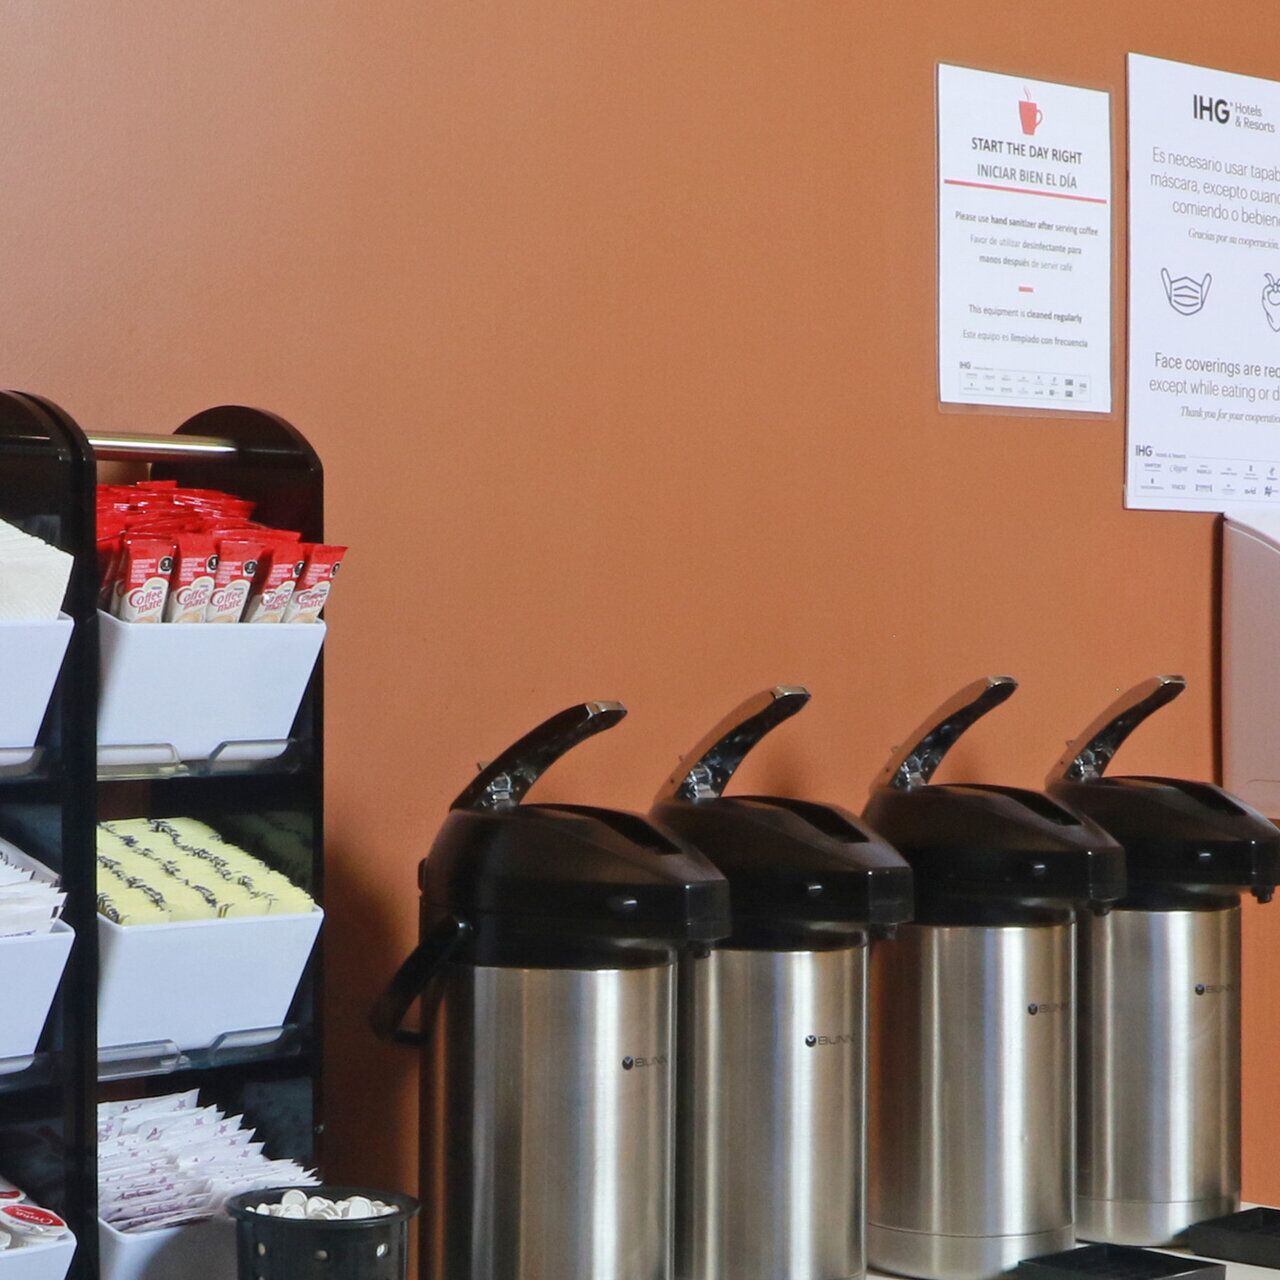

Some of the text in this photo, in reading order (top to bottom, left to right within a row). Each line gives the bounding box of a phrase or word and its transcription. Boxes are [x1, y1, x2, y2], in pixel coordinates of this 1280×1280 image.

[1192, 93, 1231, 125] IHG
[1234, 101, 1263, 118] Hotels
[1234, 117, 1276, 134] & Resorts
[971, 137, 1082, 164] START THE DAY RIGHT
[1152, 146, 1166, 164] Es
[1168, 151, 1223, 173] necesario
[1224, 160, 1248, 177] usar
[977, 163, 1077, 189] INICIAR BIEN EL DÍA
[1150, 172, 1201, 195] máscara,
[1203, 181, 1248, 200] excepto
[1172, 200, 1230, 221] comiendo
[1231, 209, 1240, 222] o
[955, 210, 1099, 237] Please use hand sanitizer after serving coffee
[1188, 227, 1216, 241] Gracias
[1215, 232, 1228, 244] por
[979, 255, 1001, 265] manos
[969, 304, 982, 315] This
[983, 306, 1019, 318] equipment
[1026, 309, 1053, 321] cleaned
[1053, 312, 1083, 325] regularly
[977, 332, 1000, 342] equipo
[1054, 335, 1088, 348] frecuencia
[1155, 352, 1182, 369] Face
[1185, 357, 1241, 378] coverings
[1243, 363, 1261, 377] are
[1149, 379, 1188, 395] except
[1190, 381, 1219, 395] while
[1221, 385, 1256, 403] eating
[1258, 387, 1270, 399] or
[1180, 406, 1203, 418] Thank
[1202, 409, 1216, 420] you
[1216, 407, 1229, 421] for
[1228, 412, 1245, 423] your
[1135, 444, 1153, 457] IHG
[128, 589, 163, 608] Coffee
[138, 598, 163, 613] mate
[176, 588, 208, 606] Coffee
[209, 590, 244, 607] Coffee
[217, 598, 242, 612] mate
